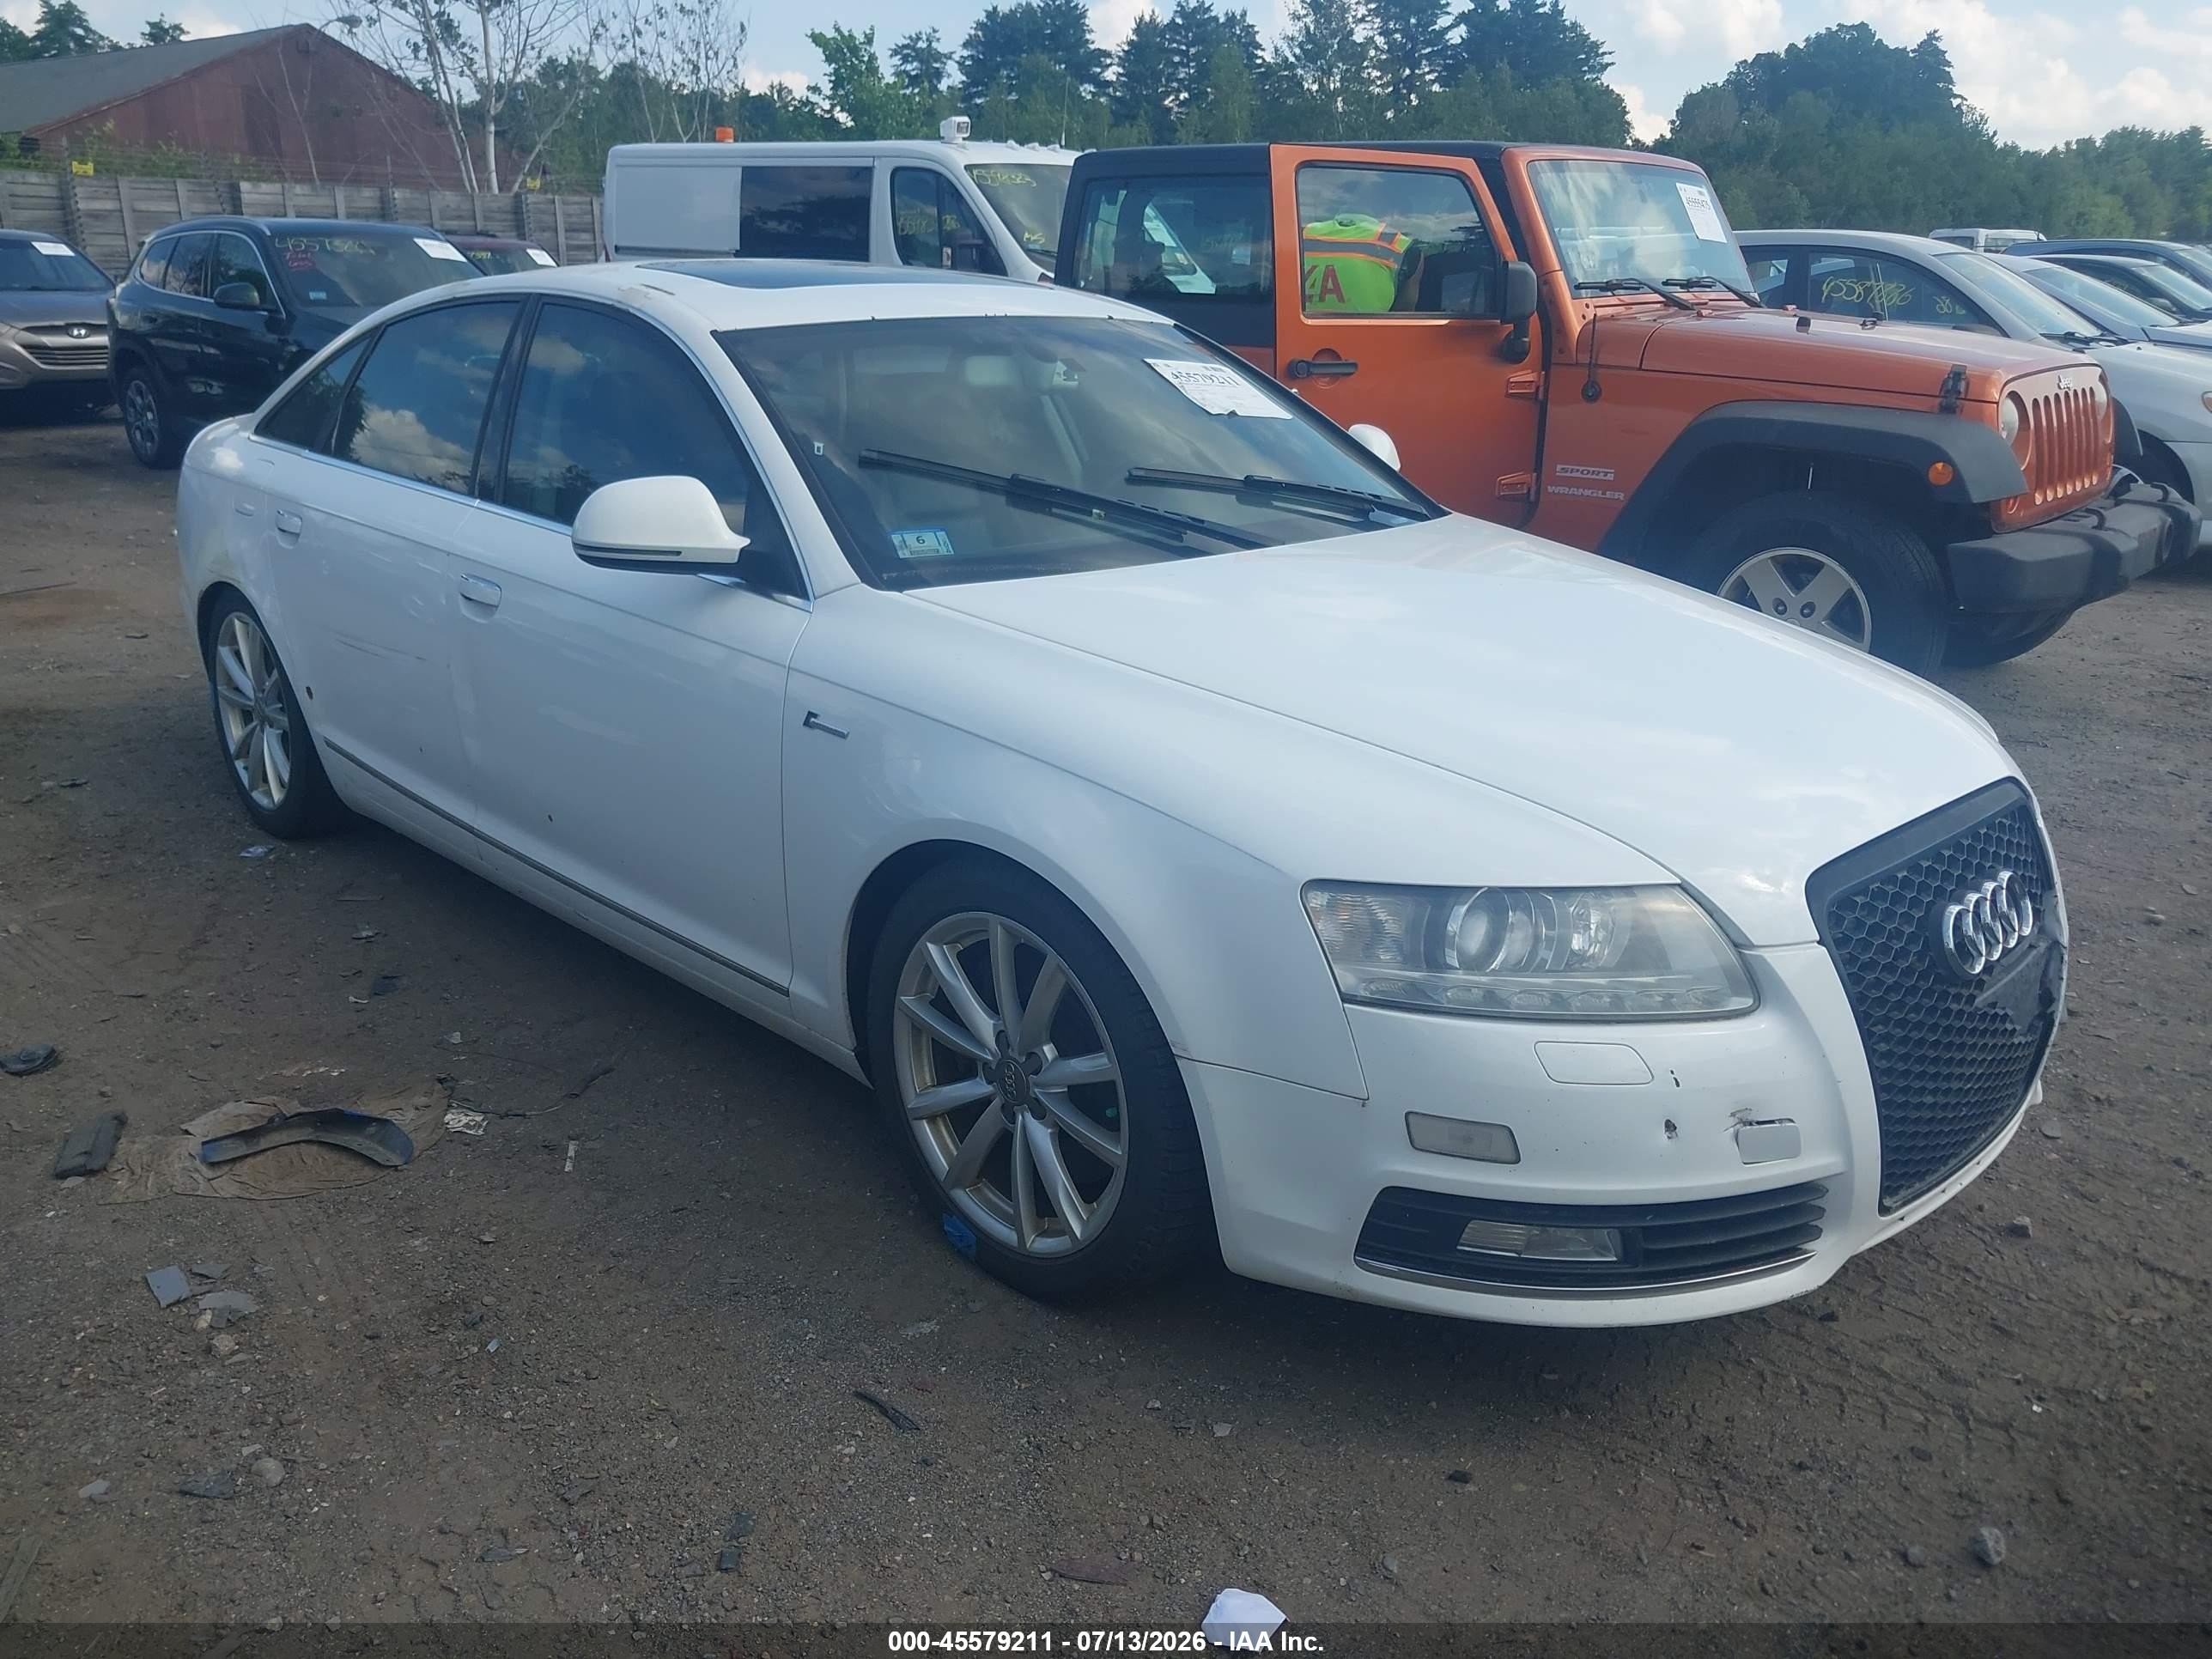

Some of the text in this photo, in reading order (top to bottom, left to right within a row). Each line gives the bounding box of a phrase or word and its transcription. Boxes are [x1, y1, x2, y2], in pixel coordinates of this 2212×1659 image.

[1170, 370, 1242, 386] 45579211
[1559, 466, 1613, 477] SPORT
[1547, 485, 1625, 501] WRANGLER
[915, 535, 926, 544] 6
